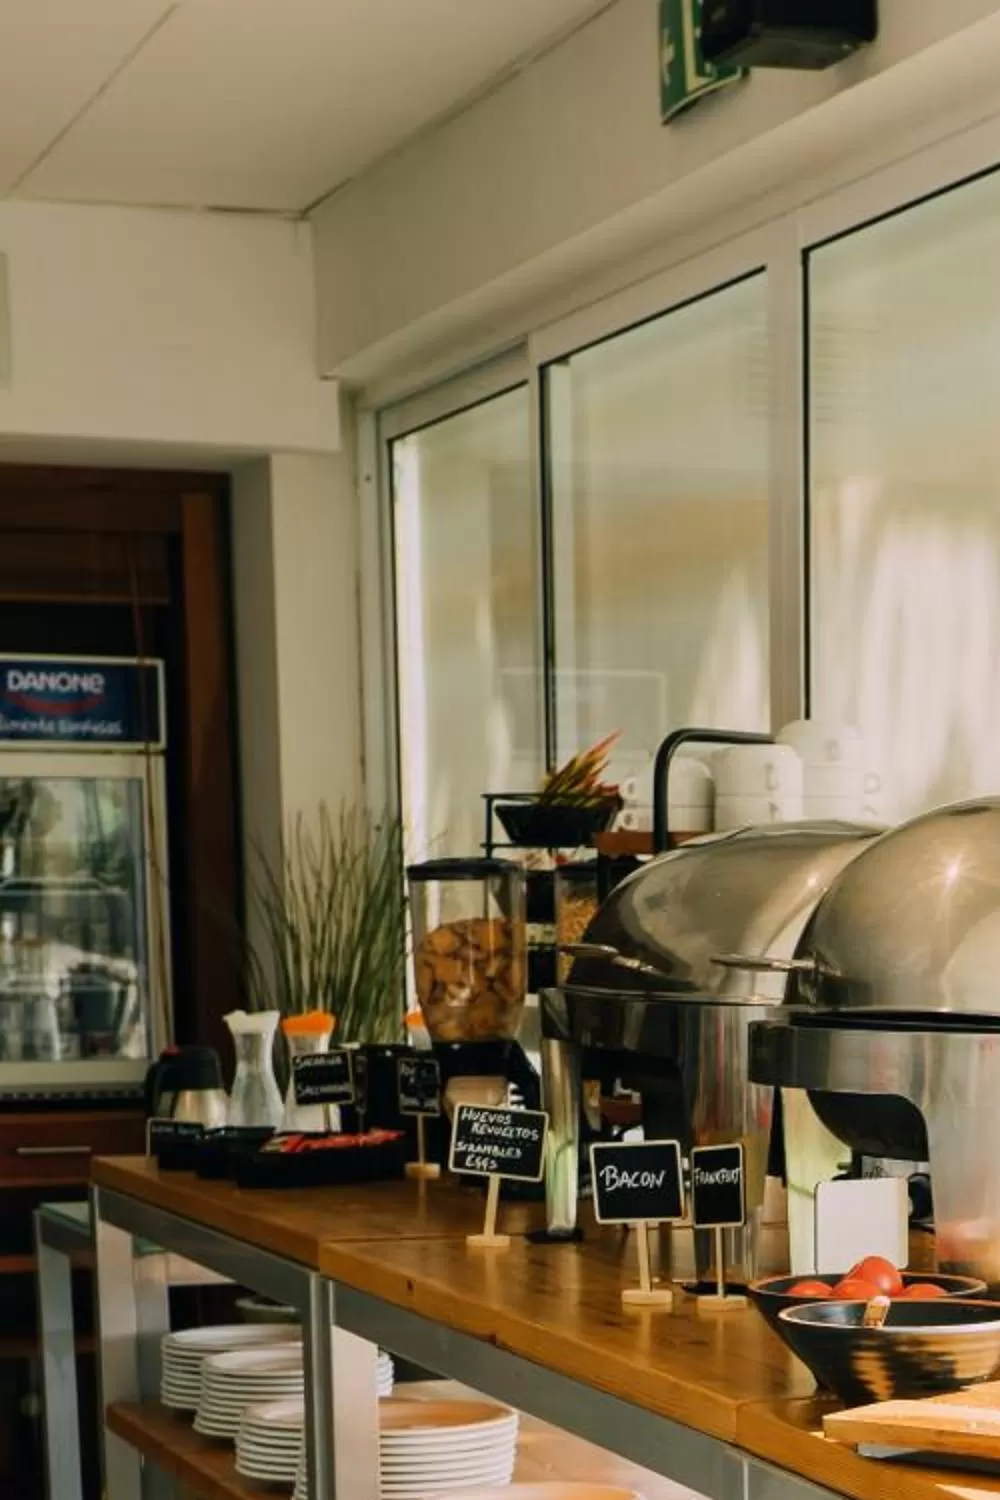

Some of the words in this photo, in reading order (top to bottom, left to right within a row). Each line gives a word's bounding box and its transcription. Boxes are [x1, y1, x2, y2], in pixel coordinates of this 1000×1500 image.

[7, 669, 105, 694] DANONE
[461, 1108, 512, 1125] HUEVOS
[600, 1165, 667, 1192] BACON
